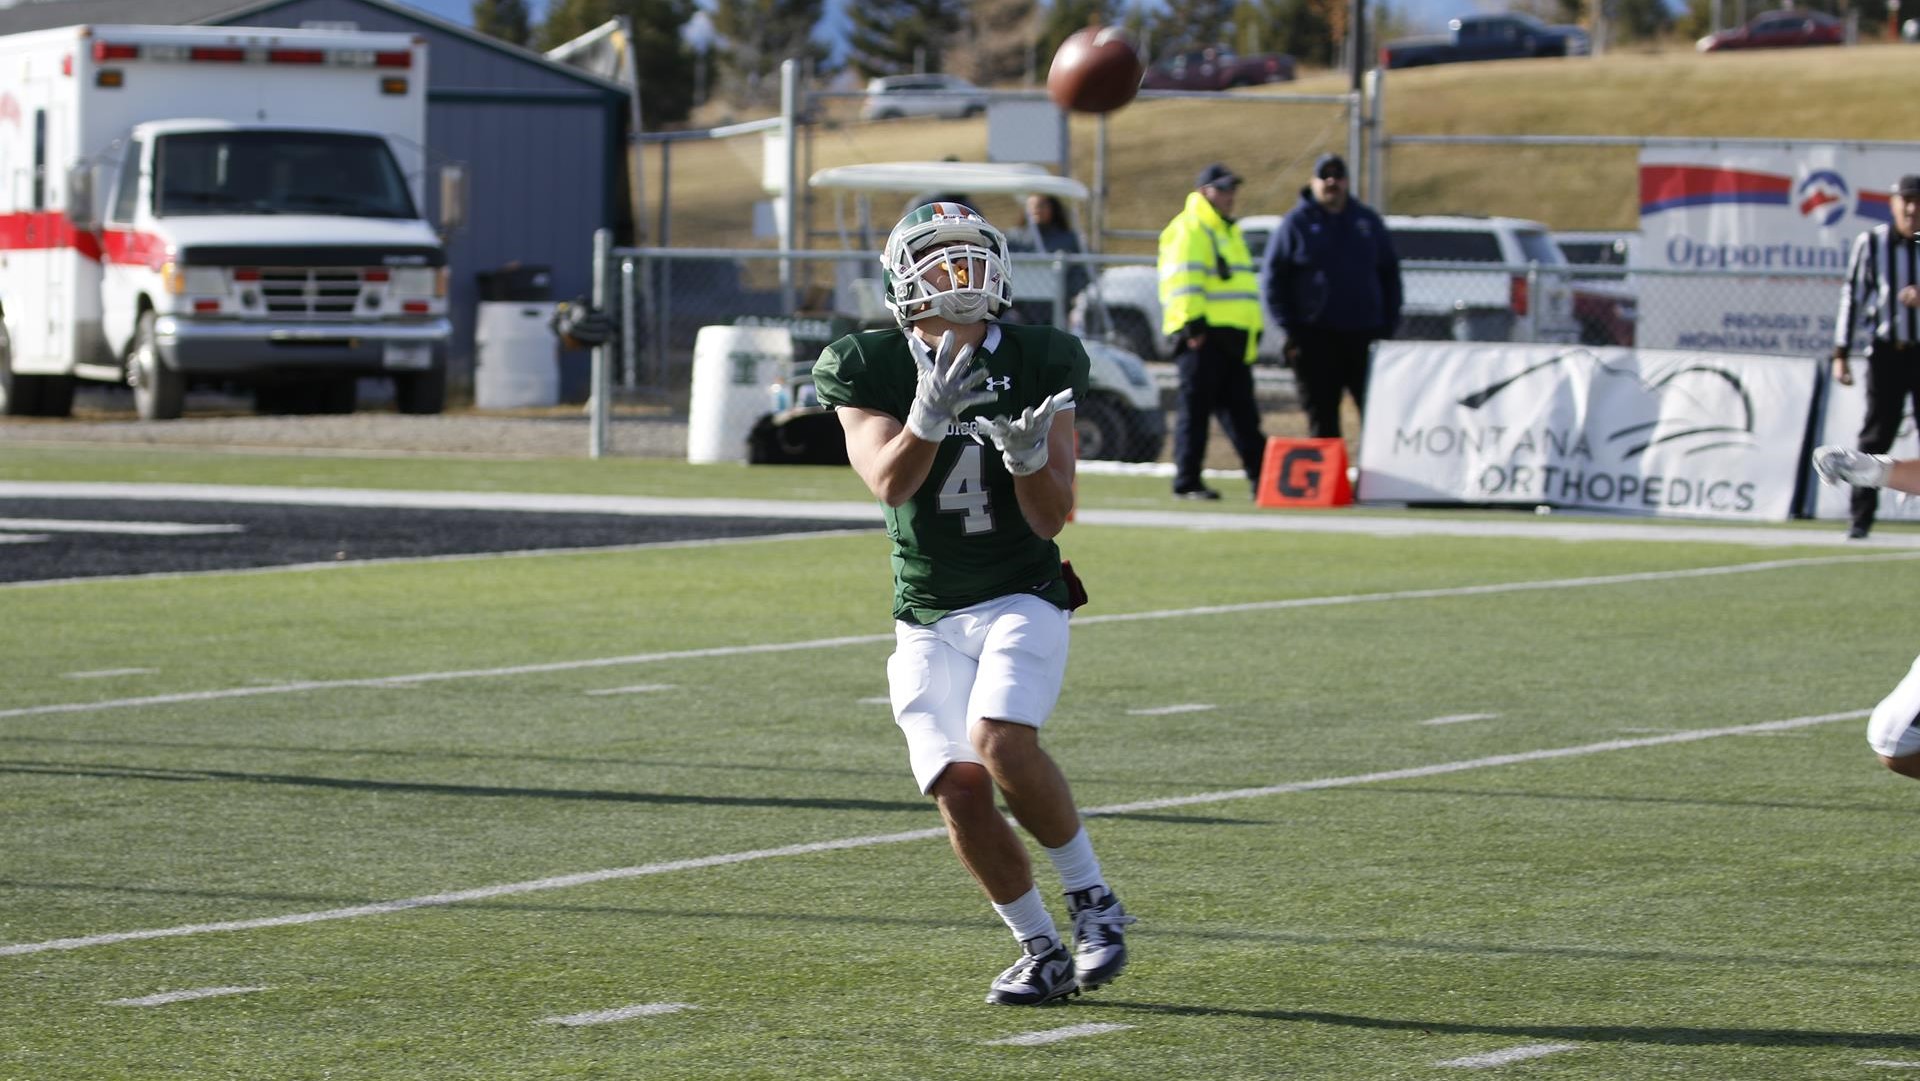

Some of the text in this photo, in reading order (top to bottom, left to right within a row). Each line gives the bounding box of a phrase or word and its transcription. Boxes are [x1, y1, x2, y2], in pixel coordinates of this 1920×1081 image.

[1666, 234, 1849, 267] Opportuni
[1677, 332, 1780, 349] MONTANA
[1393, 426, 1593, 461] MONTANA
[938, 443, 994, 534] 4
[1278, 447, 1324, 498] G
[1479, 464, 1756, 512] ORTHOPEDICS
